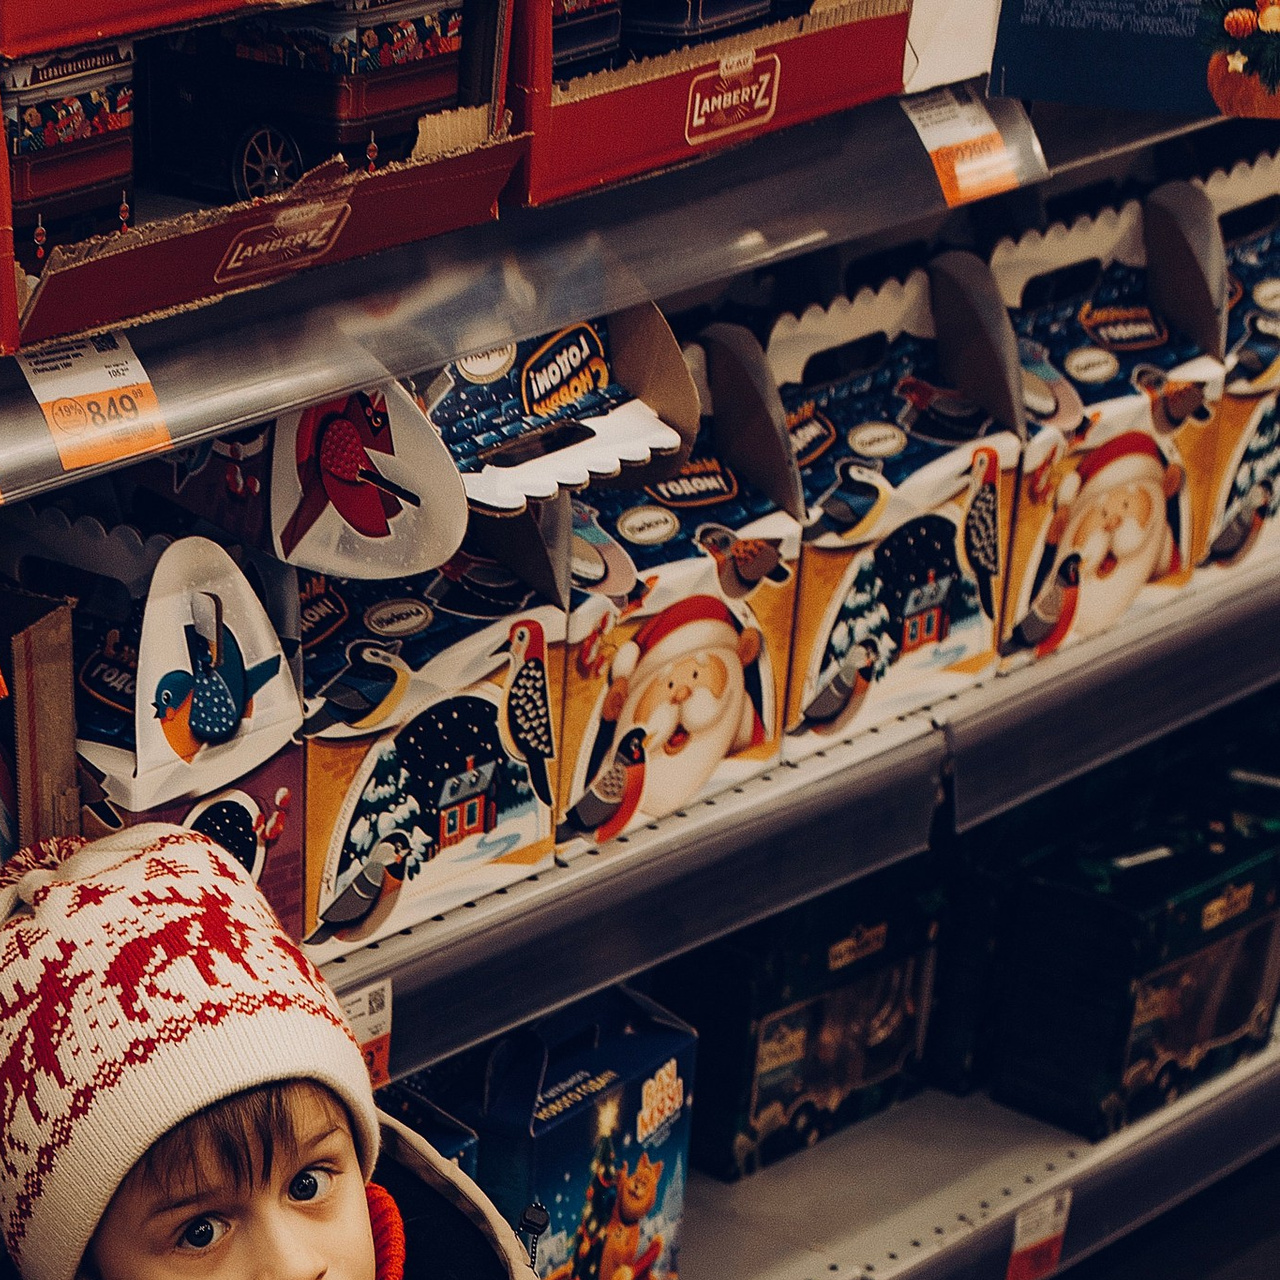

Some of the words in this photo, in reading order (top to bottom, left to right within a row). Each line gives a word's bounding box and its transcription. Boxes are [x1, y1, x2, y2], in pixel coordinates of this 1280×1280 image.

[693, 72, 771, 128] LAMBERTZ
[227, 217, 337, 270] LAMBERTZ
[530, 334, 590, 399] ГОДОМ!
[87, 394, 140, 429] 849
